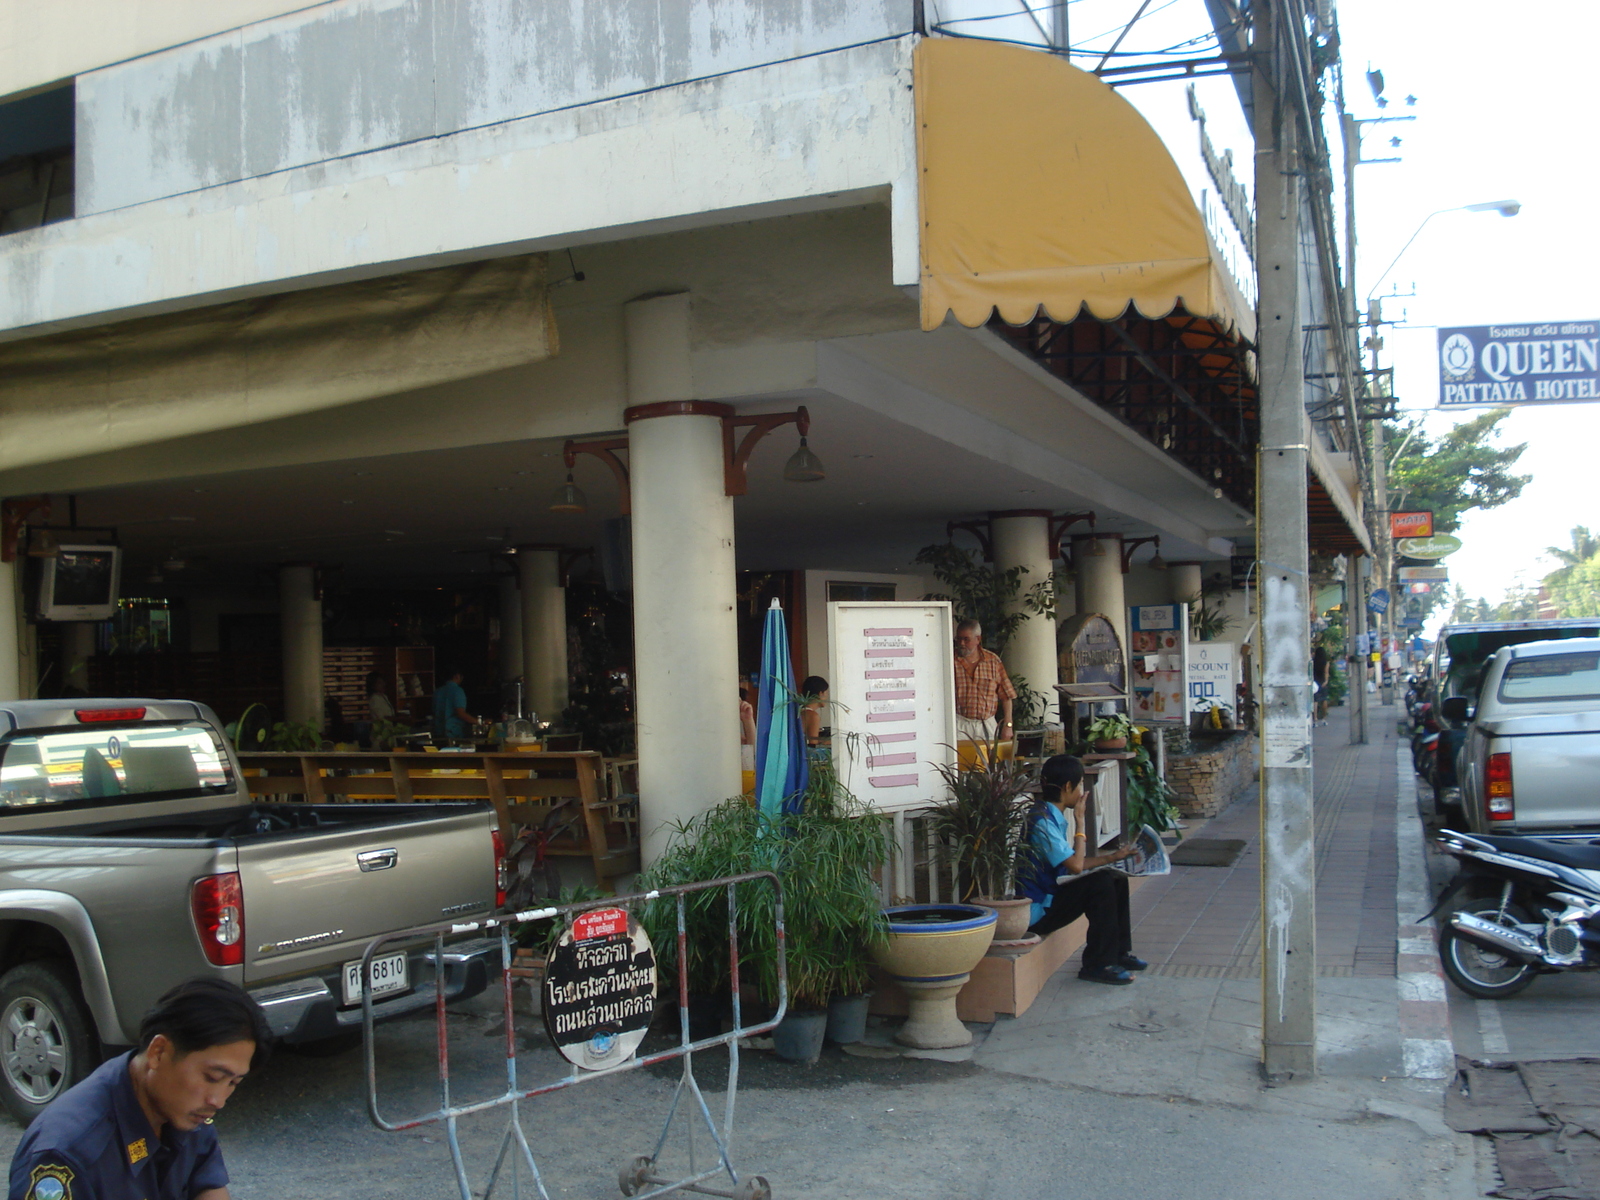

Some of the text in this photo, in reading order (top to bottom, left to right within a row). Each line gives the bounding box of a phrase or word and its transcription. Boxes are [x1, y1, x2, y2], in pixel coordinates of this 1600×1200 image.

[1481, 339, 1599, 382] QUEEN
[1444, 378, 1600, 403] PATTAYA HOTEL
[1188, 662, 1230, 671] ISCOUNT
[373, 957, 404, 981] 6810
